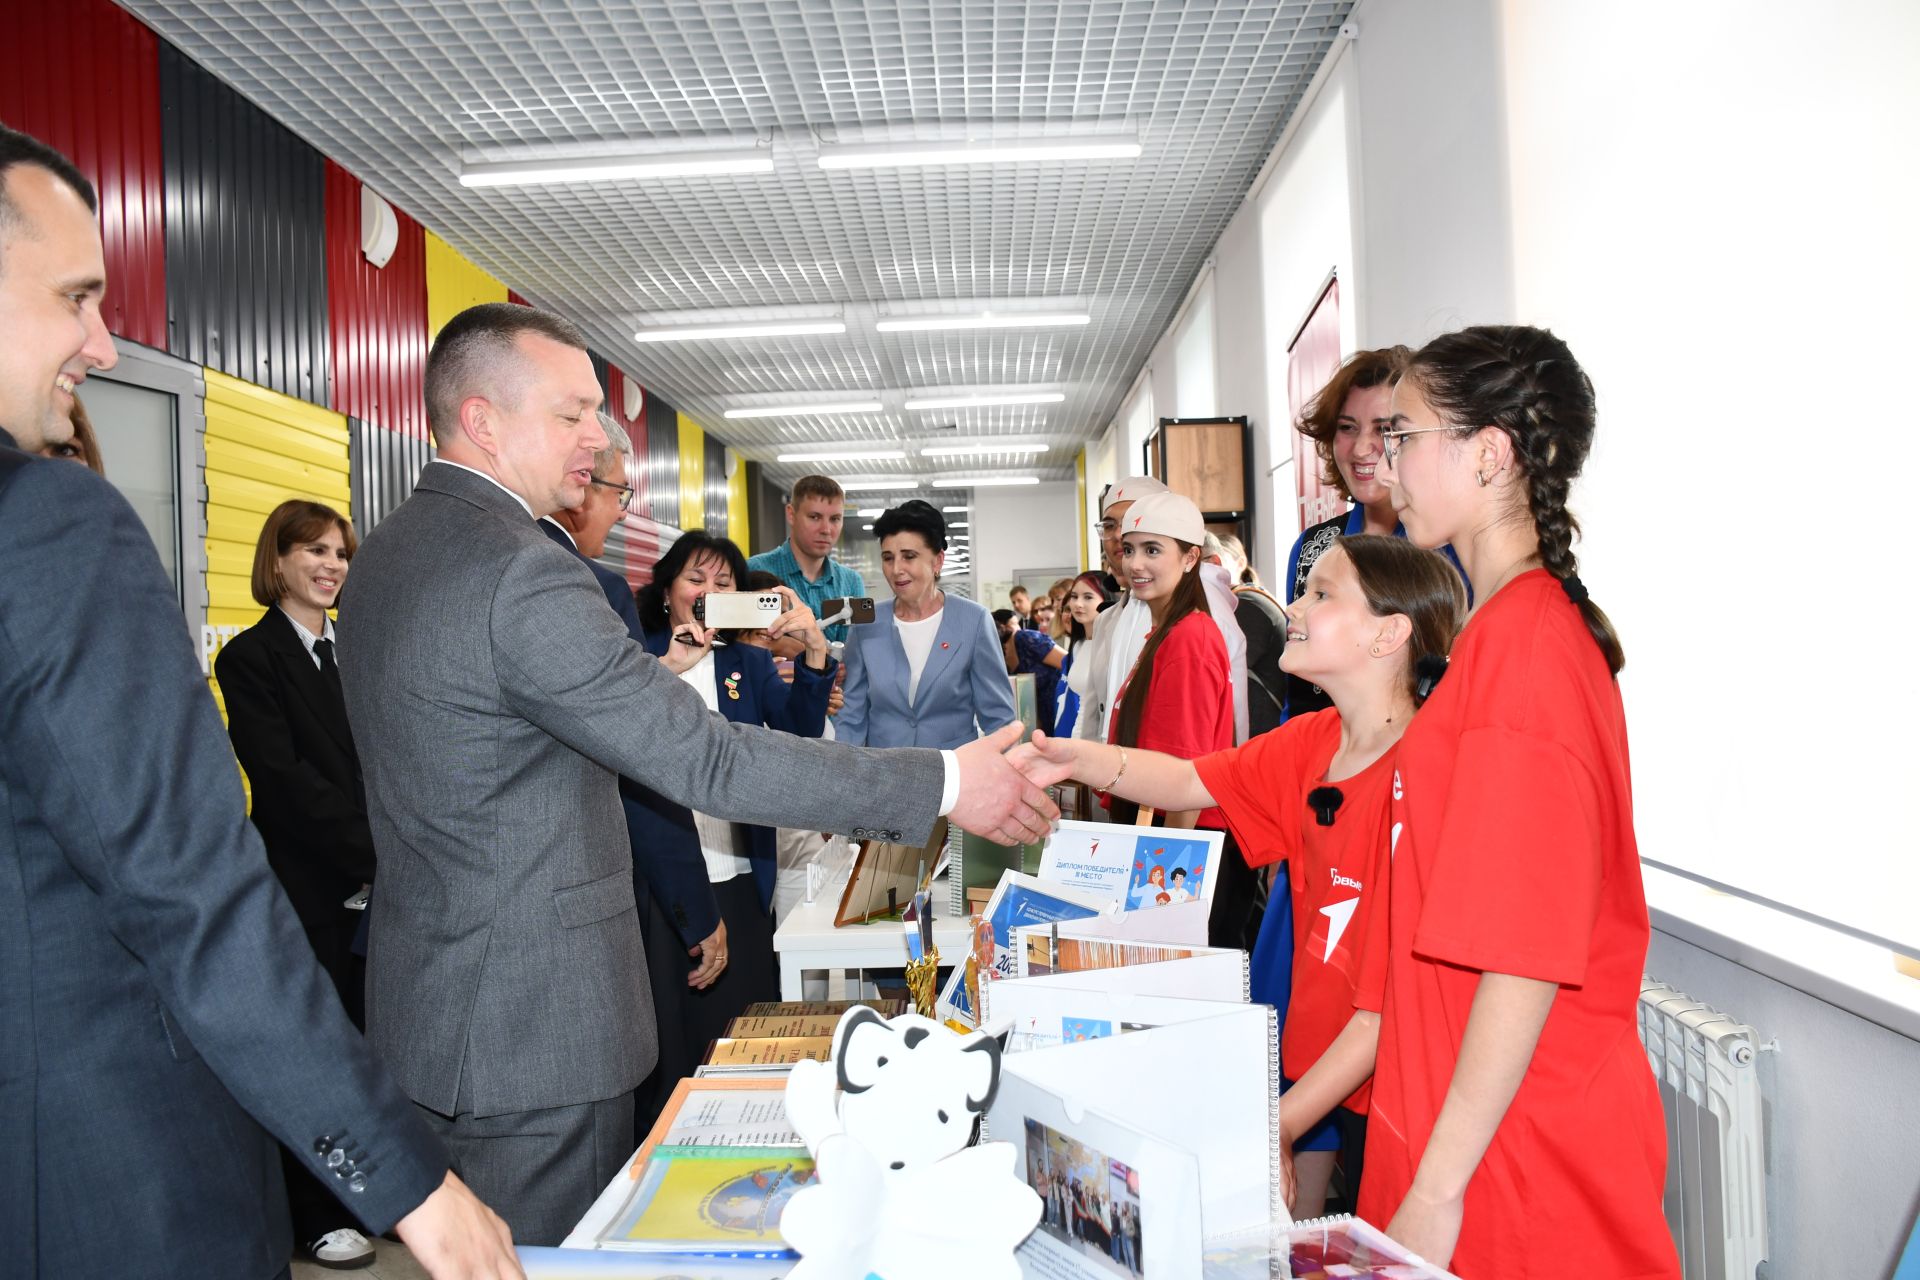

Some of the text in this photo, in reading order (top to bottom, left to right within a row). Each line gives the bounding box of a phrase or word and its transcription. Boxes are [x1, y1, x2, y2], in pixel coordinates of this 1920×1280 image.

[1056, 861, 1125, 874] ДИПЛОМ ПОБЕДИТЕЛЯ
[1080, 872, 1103, 880] МЕСТО
